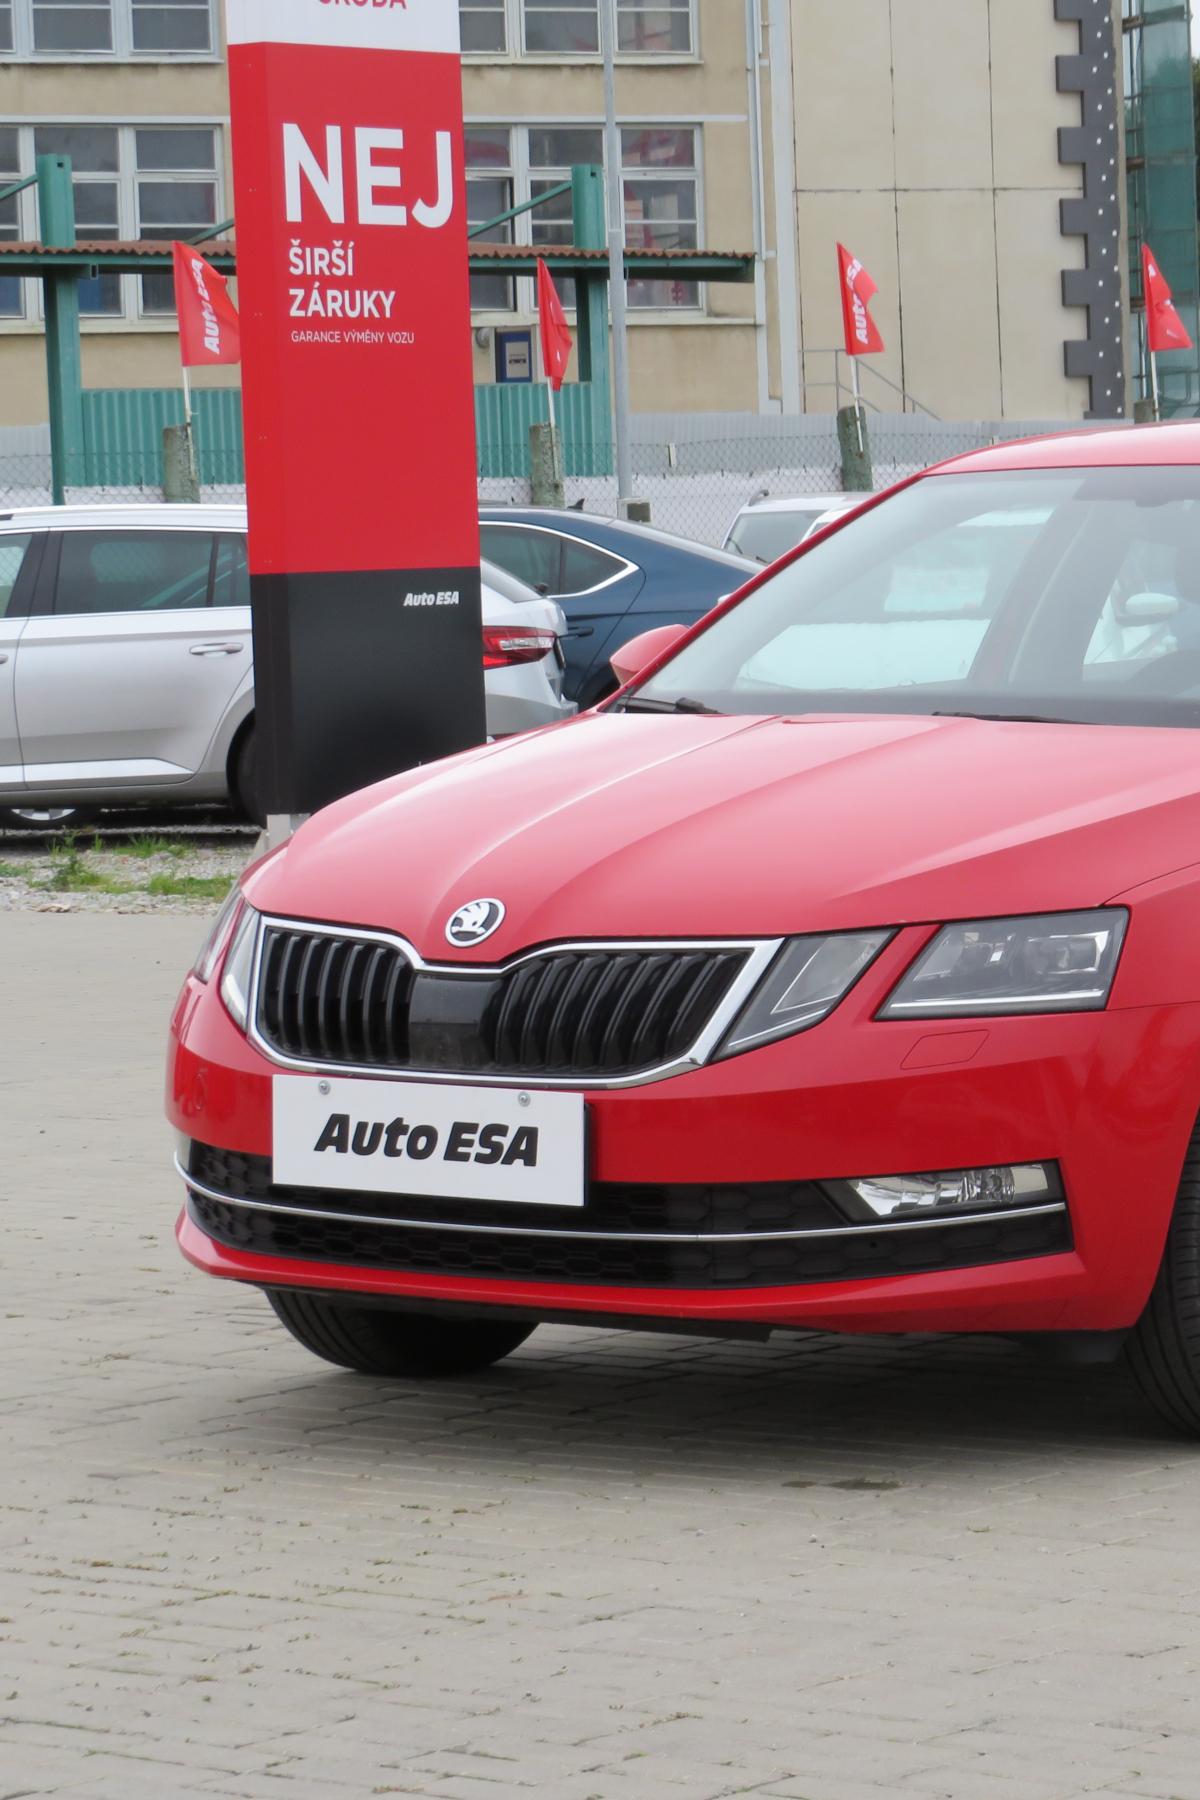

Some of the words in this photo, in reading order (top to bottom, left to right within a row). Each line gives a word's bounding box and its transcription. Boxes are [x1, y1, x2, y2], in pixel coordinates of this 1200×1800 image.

[282, 122, 453, 228] NEJ
[288, 238, 355, 277] ŠIRŠÍ
[288, 281, 396, 318] ZÁRUKY
[291, 330, 341, 343] GARANCE
[343, 328, 385, 343] VÝMĚNY
[387, 331, 415, 344] VOZU
[403, 591, 435, 607] Auto
[435, 590, 460, 605] ESA
[314, 1113, 439, 1159] Auto
[443, 1121, 539, 1167] ESA
